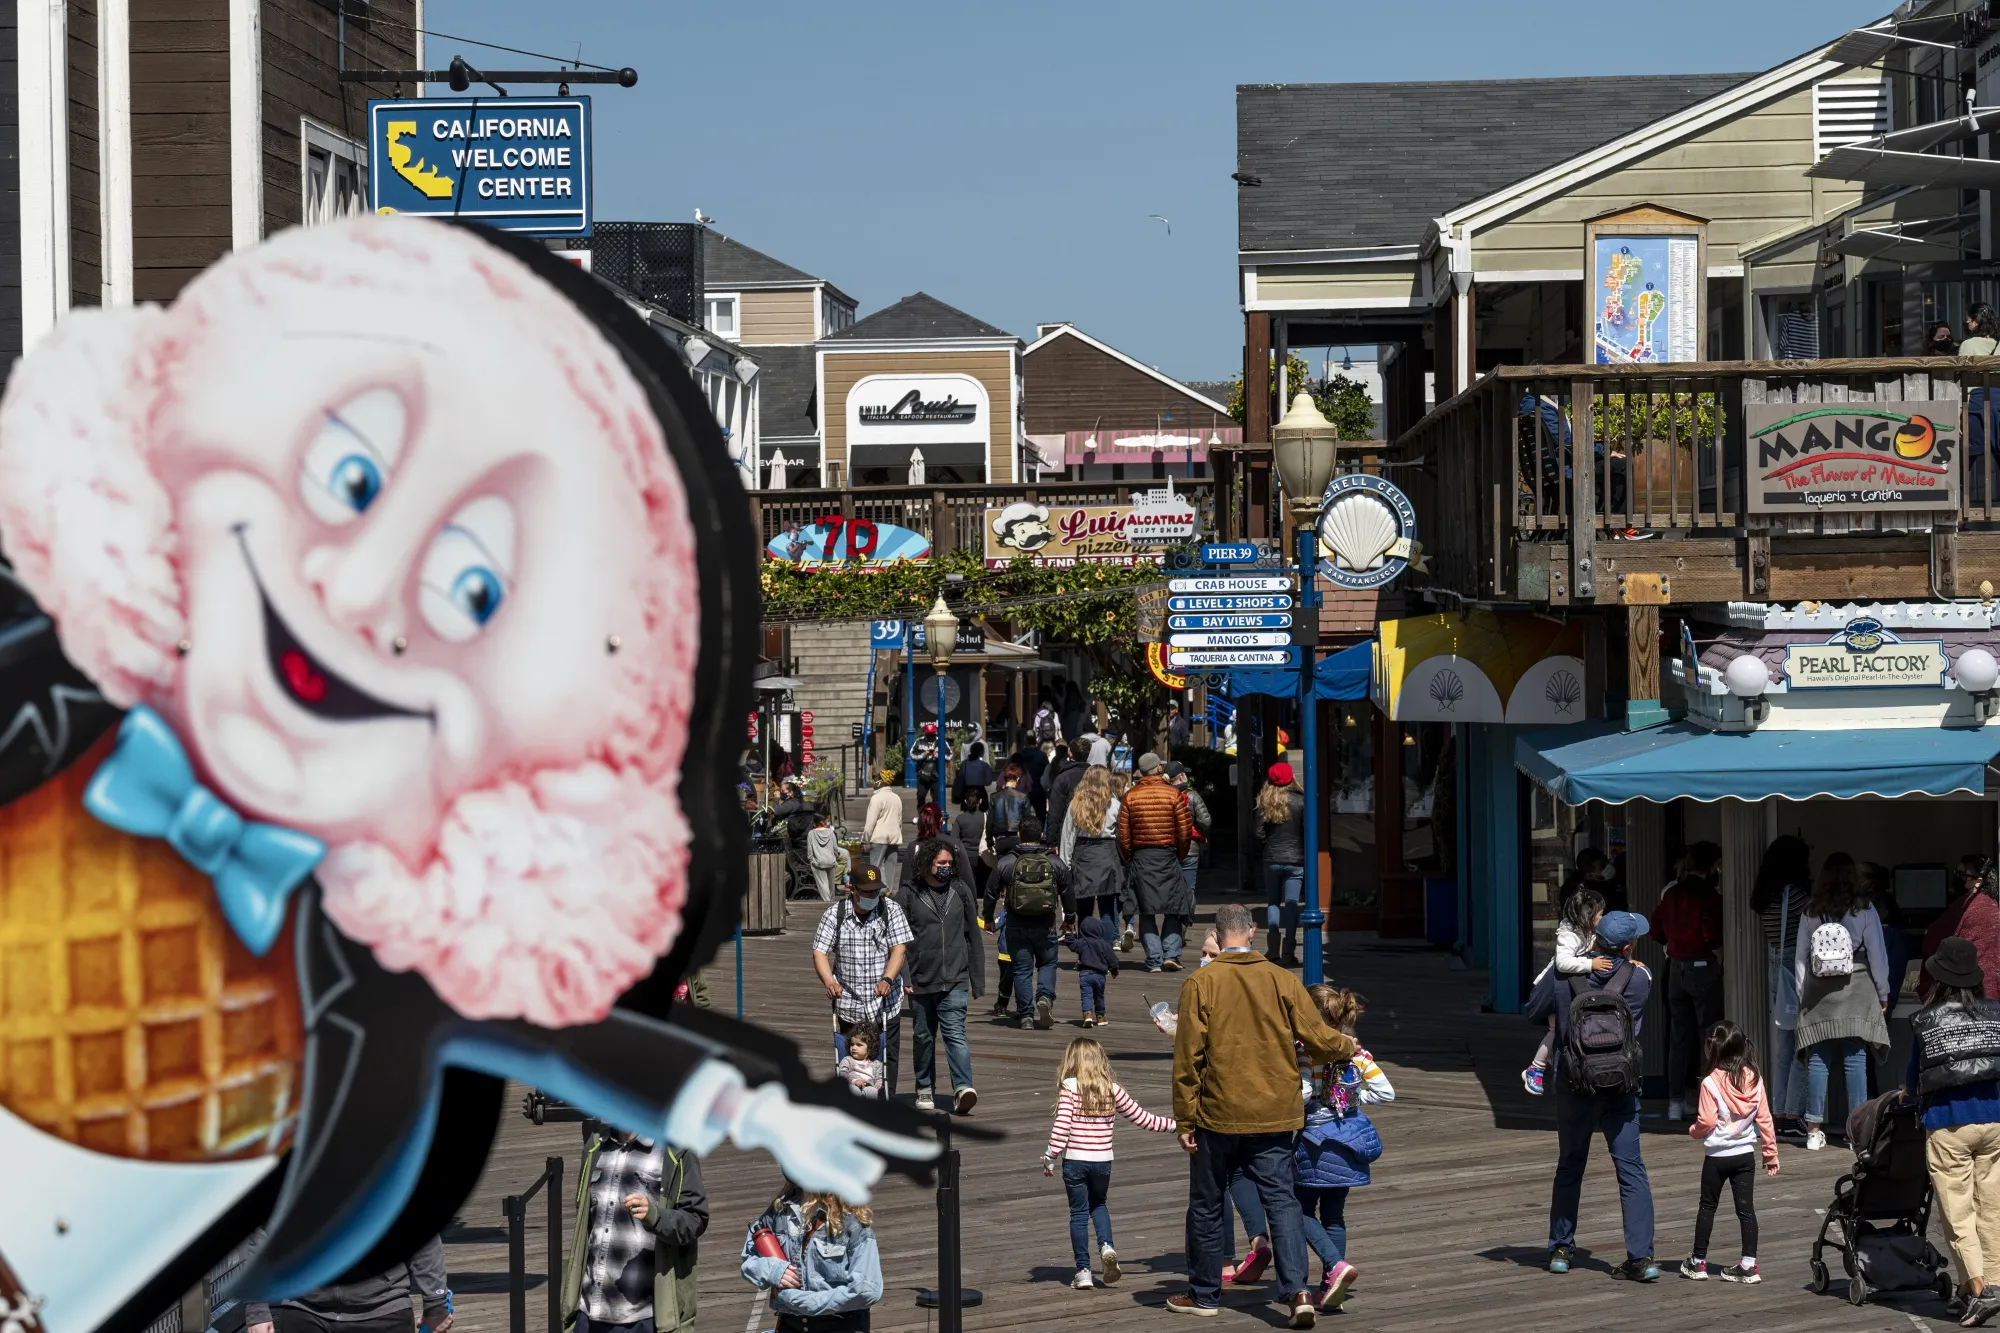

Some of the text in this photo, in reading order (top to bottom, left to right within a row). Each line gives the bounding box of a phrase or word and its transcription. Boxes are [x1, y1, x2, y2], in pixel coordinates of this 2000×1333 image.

[433, 118, 571, 138] CALIFORNIA
[451, 148, 571, 167] WELCOME
[478, 177, 571, 196] CENTER
[1779, 463, 1936, 490] The Flavor of Mexico
[1324, 477, 1414, 528] SHELL CELLAR
[1804, 490, 1847, 509] Taqueria
[1861, 489, 1903, 502] Cantina
[1127, 513, 1194, 526] ALCATRAZ
[816, 515, 879, 557] 7D
[1208, 548, 1251, 559] PIER 39
[1397, 543, 1419, 556] 1978
[994, 558, 1010, 569] AT
[1047, 557, 1076, 568] END
[1327, 566, 1396, 584] SAN FRANCISCO
[1195, 579, 1267, 590] CRAB HOUSE
[1189, 598, 1274, 609] LEVEL 2 SHOPS
[1202, 616, 1263, 627] BAY VIEWS
[873, 619, 901, 640] 39
[966, 634, 981, 643] hut
[1207, 635, 1259, 645] MANGO'S
[1190, 653, 1274, 663] TAQUERIA & CANTINA
[1799, 655, 1930, 674] PEARL FACTORY
[1163, 673, 1187, 687] STO
[1807, 673, 1924, 683] Hawaii's Original Pearl-In-The-Oyster
[950, 719, 963, 728] hut
